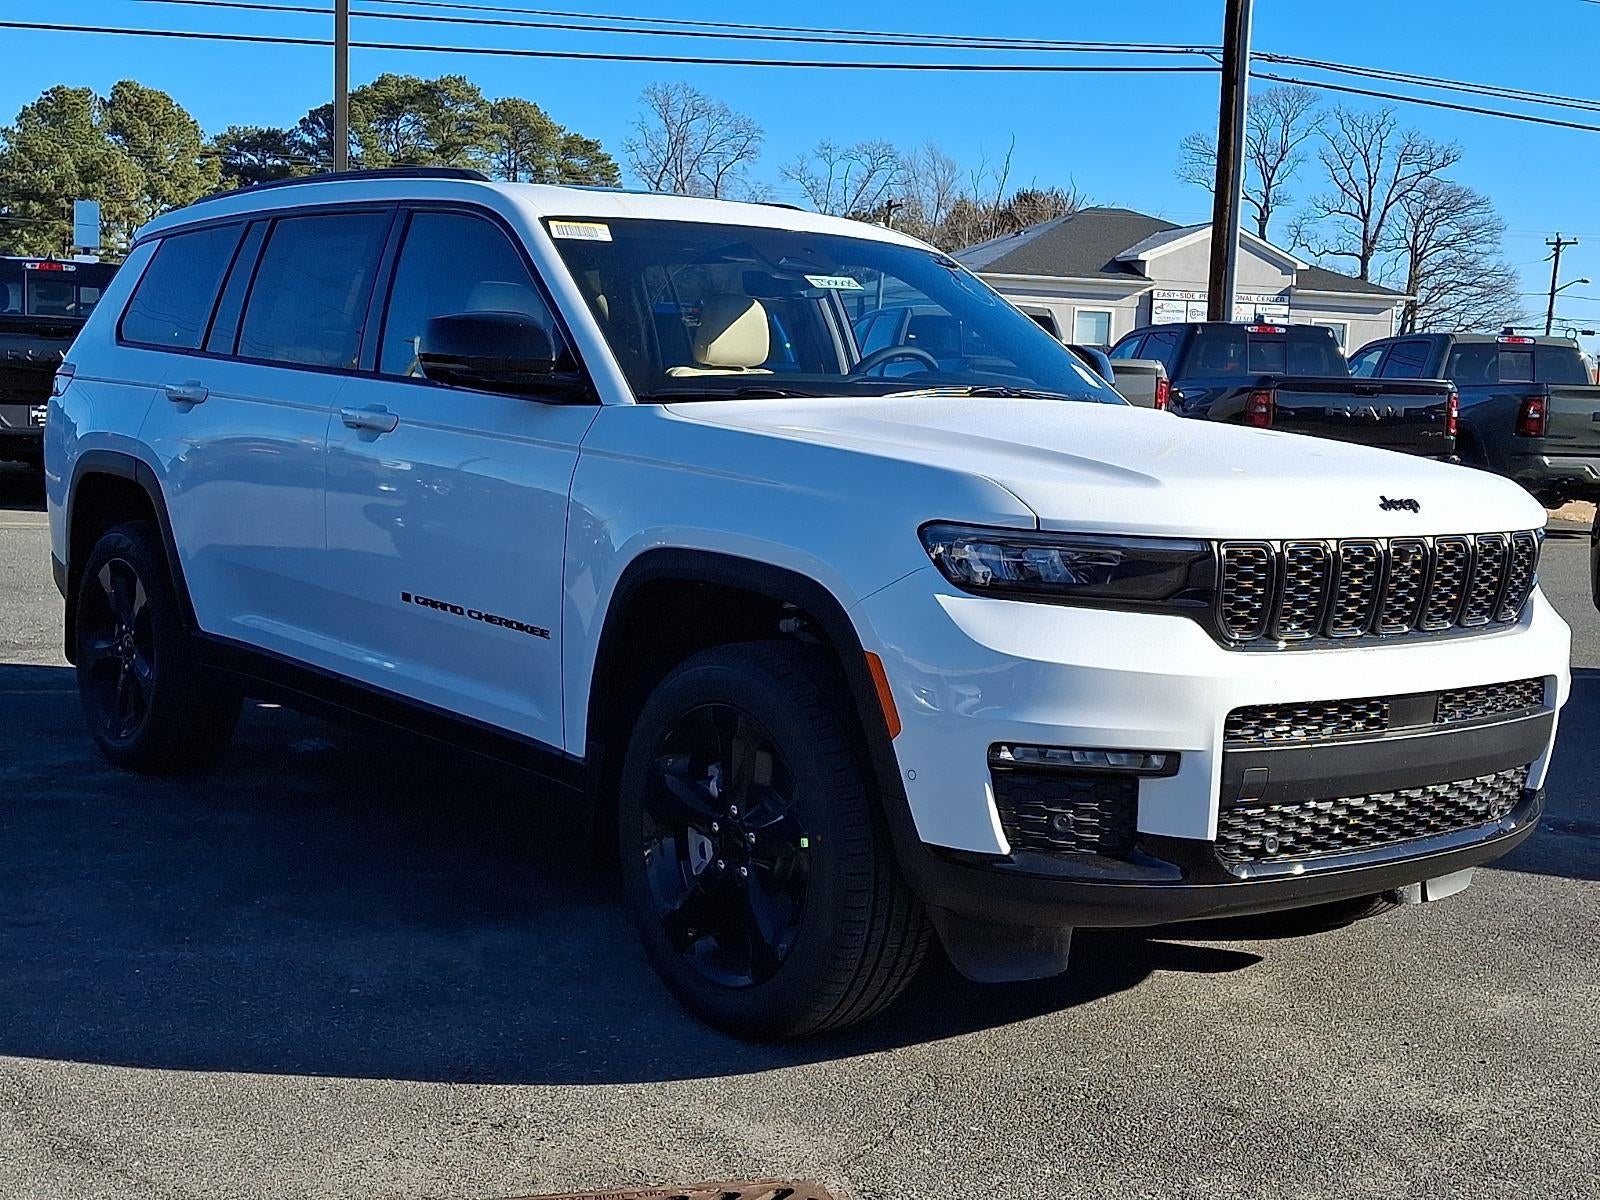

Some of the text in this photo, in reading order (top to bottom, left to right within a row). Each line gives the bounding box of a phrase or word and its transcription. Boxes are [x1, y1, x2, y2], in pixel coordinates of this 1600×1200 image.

[1156, 291, 1196, 299] EAST-SIDE
[1256, 295, 1287, 303] CENTER
[1379, 495, 1420, 513] Jeep
[414, 595, 551, 640] GRAND CHEROKEE
